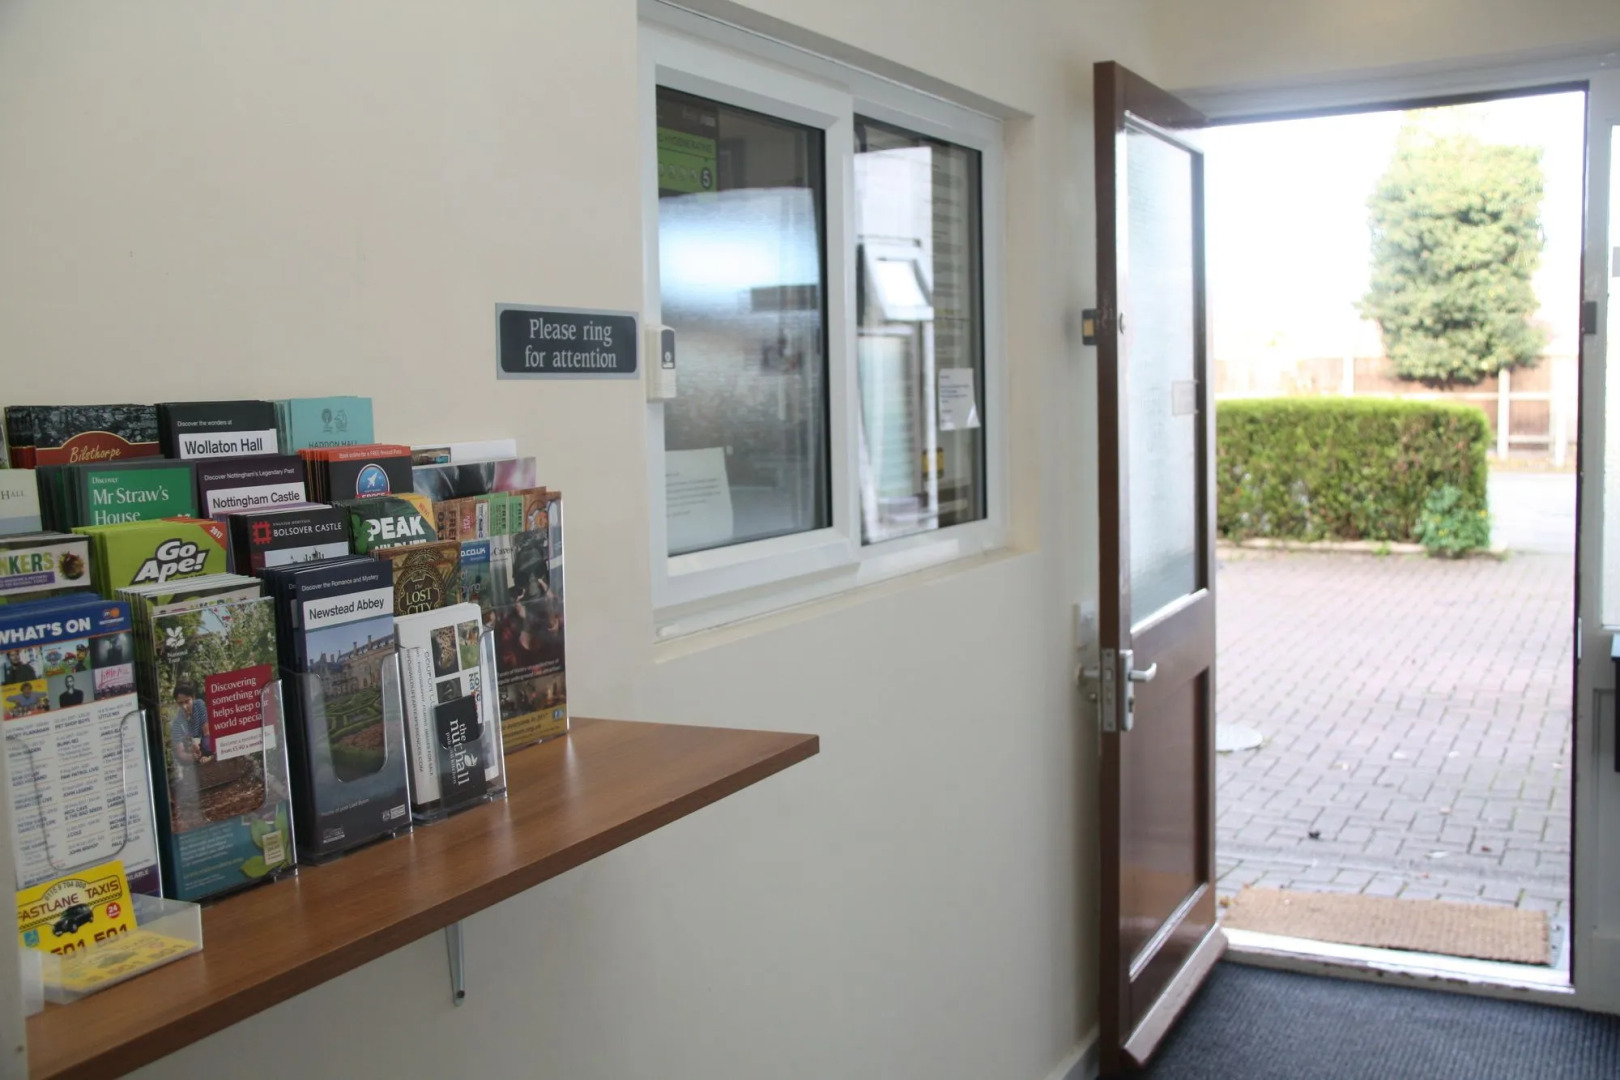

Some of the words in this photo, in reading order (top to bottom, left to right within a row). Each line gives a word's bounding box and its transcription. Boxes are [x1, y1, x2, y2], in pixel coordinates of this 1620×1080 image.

[529, 318, 576, 340] Please
[583, 321, 612, 347] ring
[525, 345, 546, 368] for
[552, 349, 617, 368] attention
[70, 445, 120, 463] Bilsthorpe
[185, 440, 237, 454] Wollaton
[241, 438, 262, 451] Hall
[94, 489, 114, 505] Mr
[117, 485, 169, 504] Straw's
[212, 494, 268, 508] Nottingham
[271, 490, 300, 502] Castle
[94, 510, 141, 525] House
[448, 510, 456, 540] FRE
[210, 526, 223, 539] 2017
[274, 526, 312, 537] BOLSOVER
[315, 522, 342, 532] CASTLE
[366, 515, 424, 542] PEAK
[157, 541, 197, 561] Go
[134, 552, 206, 583] Ape!
[302, 583, 322, 591] Discover
[362, 574, 379, 582] Mystery
[406, 588, 432, 605] LOST
[309, 602, 354, 620] Newstead
[357, 598, 384, 611] Abbey
[408, 602, 433, 615] CITY
[66, 617, 91, 634] ON
[211, 677, 256, 693] Discovering
[212, 690, 253, 706] something
[213, 706, 234, 718] helps
[236, 702, 254, 713] keep
[214, 717, 237, 730] world
[239, 712, 264, 726] specia
[450, 719, 470, 785] nuthall
[85, 880, 119, 899] TAXIS
[108, 905, 118, 913] 24
